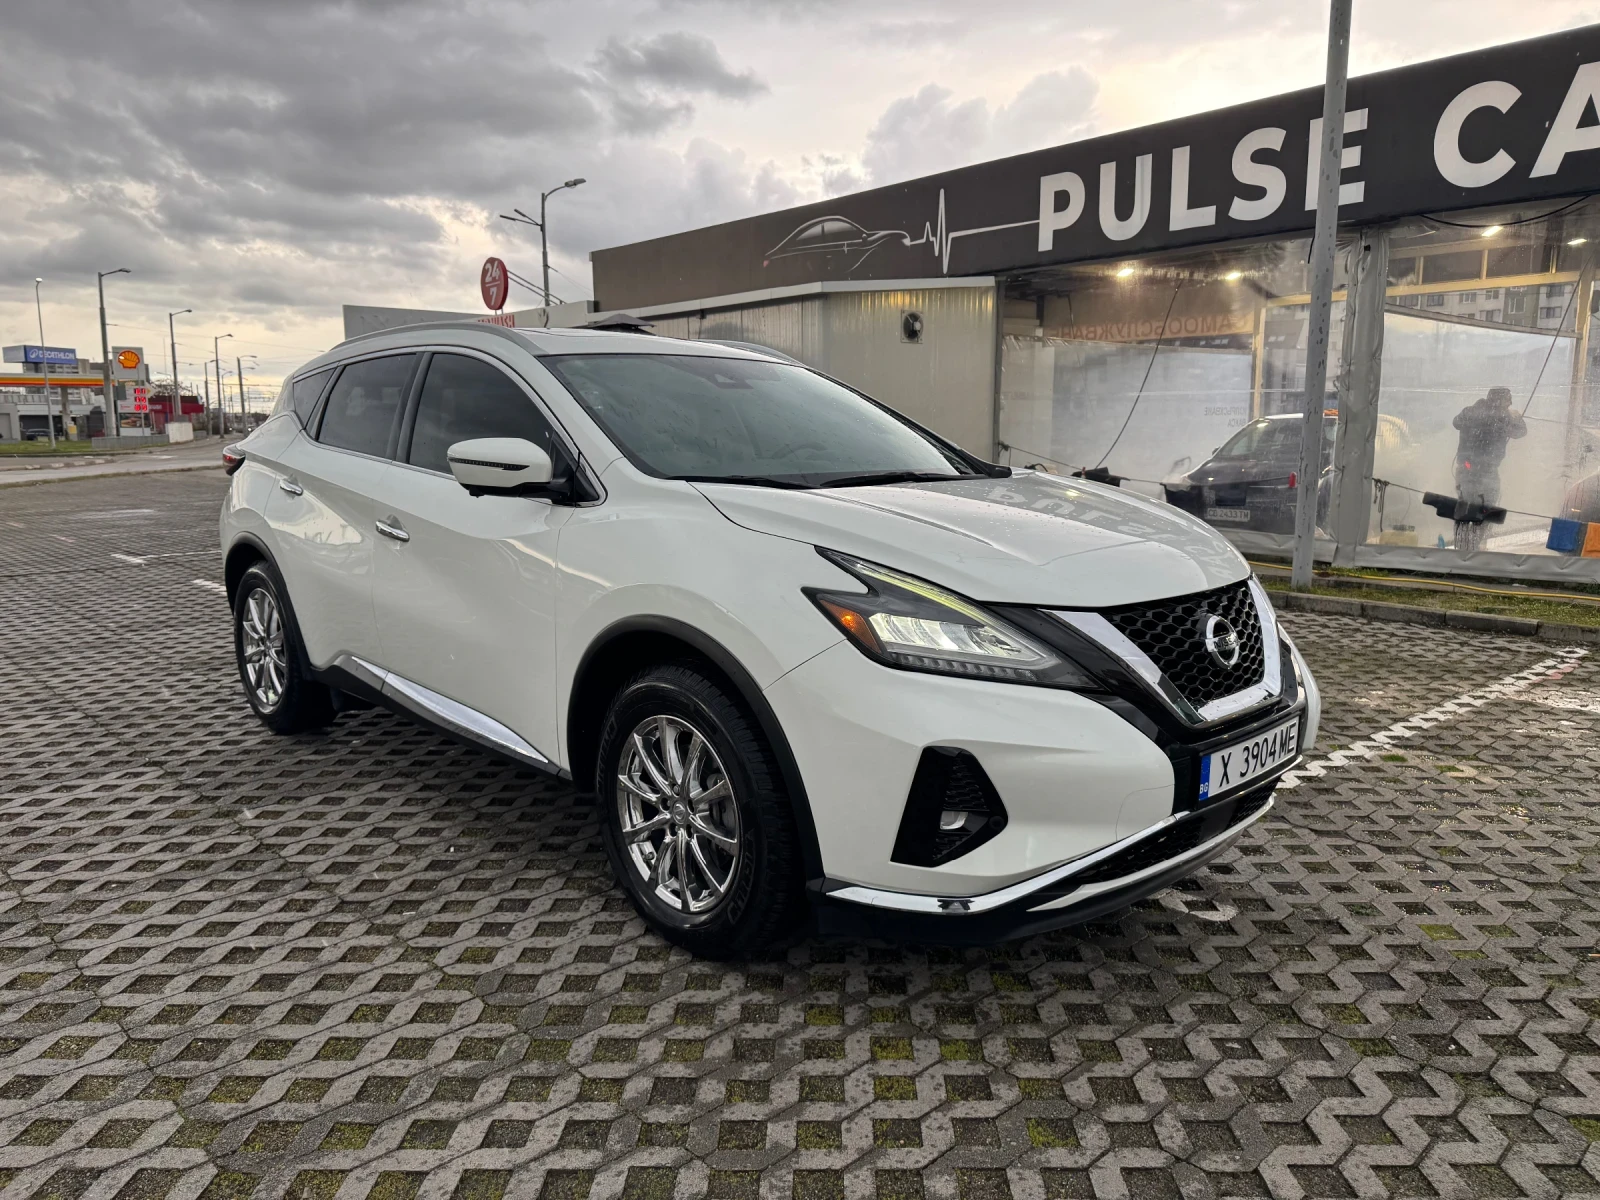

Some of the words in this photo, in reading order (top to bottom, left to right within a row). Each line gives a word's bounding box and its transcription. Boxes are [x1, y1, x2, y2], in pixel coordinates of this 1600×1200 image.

[1038, 108, 1368, 252] PULSE
[485, 261, 500, 282] 24
[490, 287, 497, 306] 7
[1220, 510, 1238, 518] 2433
[1219, 752, 1232, 788] X
[1240, 731, 1277, 777] 3904
[1279, 721, 1297, 759] ME
[1199, 782, 1209, 794] BG
